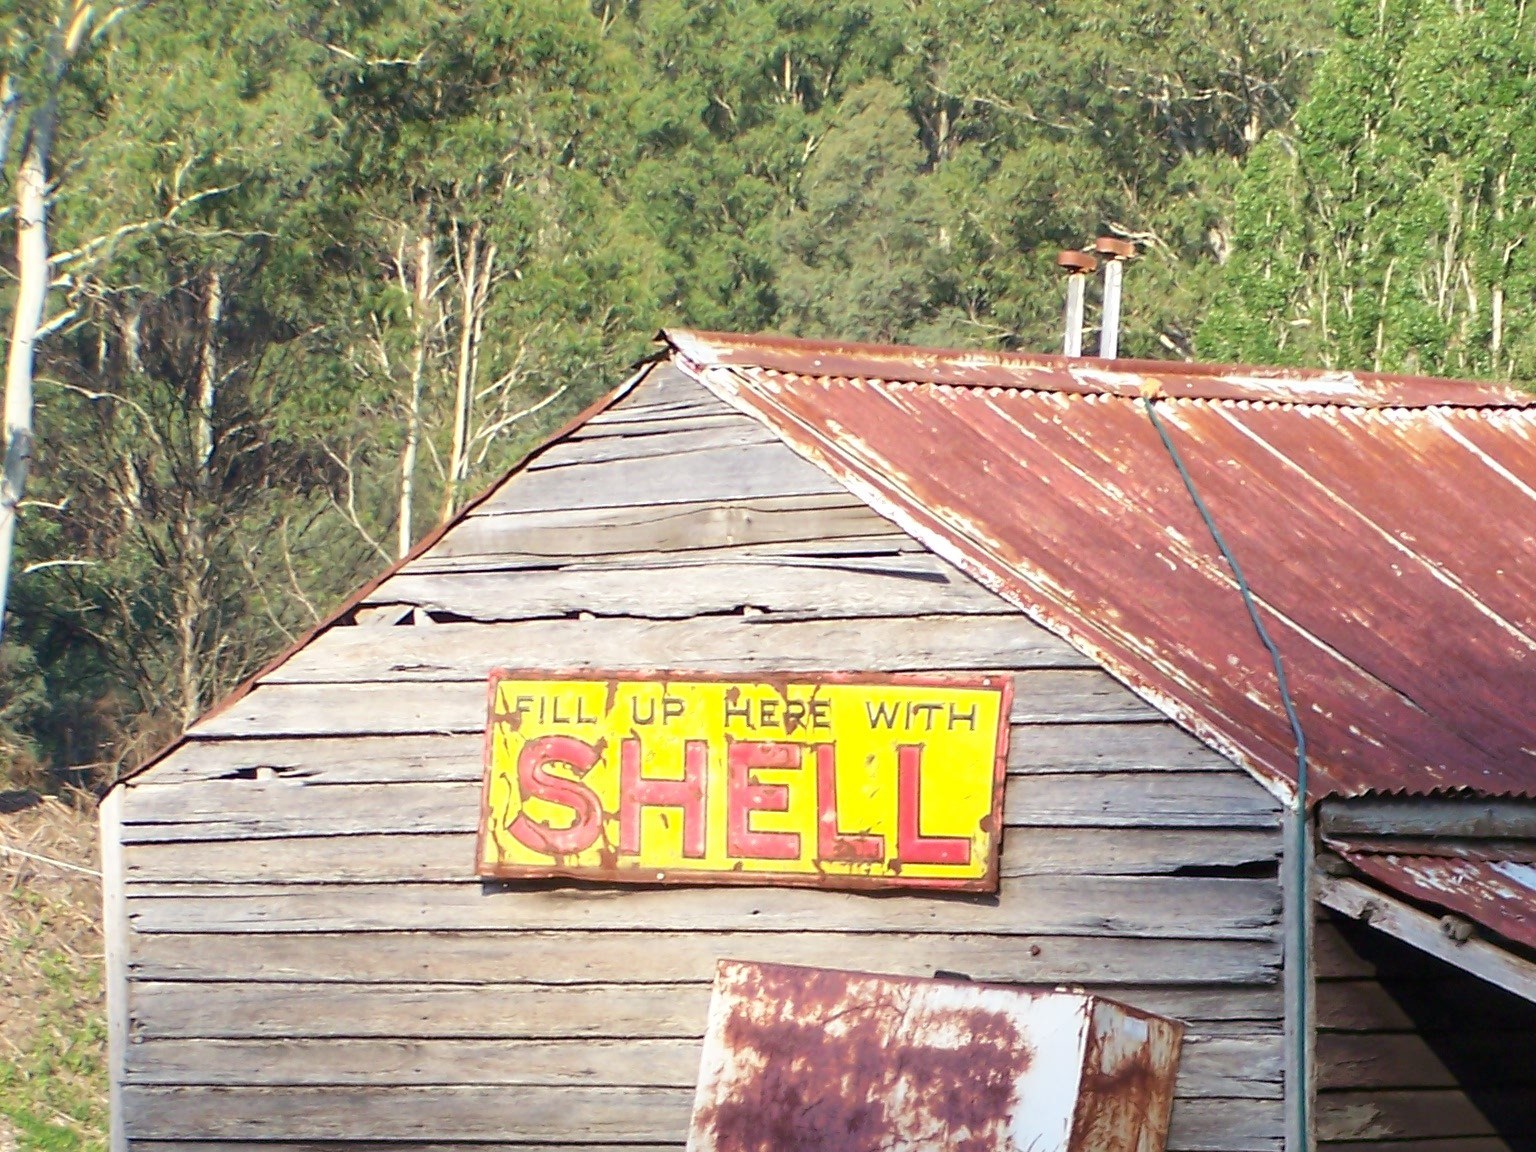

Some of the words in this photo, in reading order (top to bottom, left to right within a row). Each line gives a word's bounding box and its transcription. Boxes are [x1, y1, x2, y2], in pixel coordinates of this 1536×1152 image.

[516, 696, 597, 725] FILL
[632, 696, 685, 726] UP
[724, 697, 831, 731] HERE
[866, 701, 976, 731] WITH
[505, 734, 973, 865] SHELL
